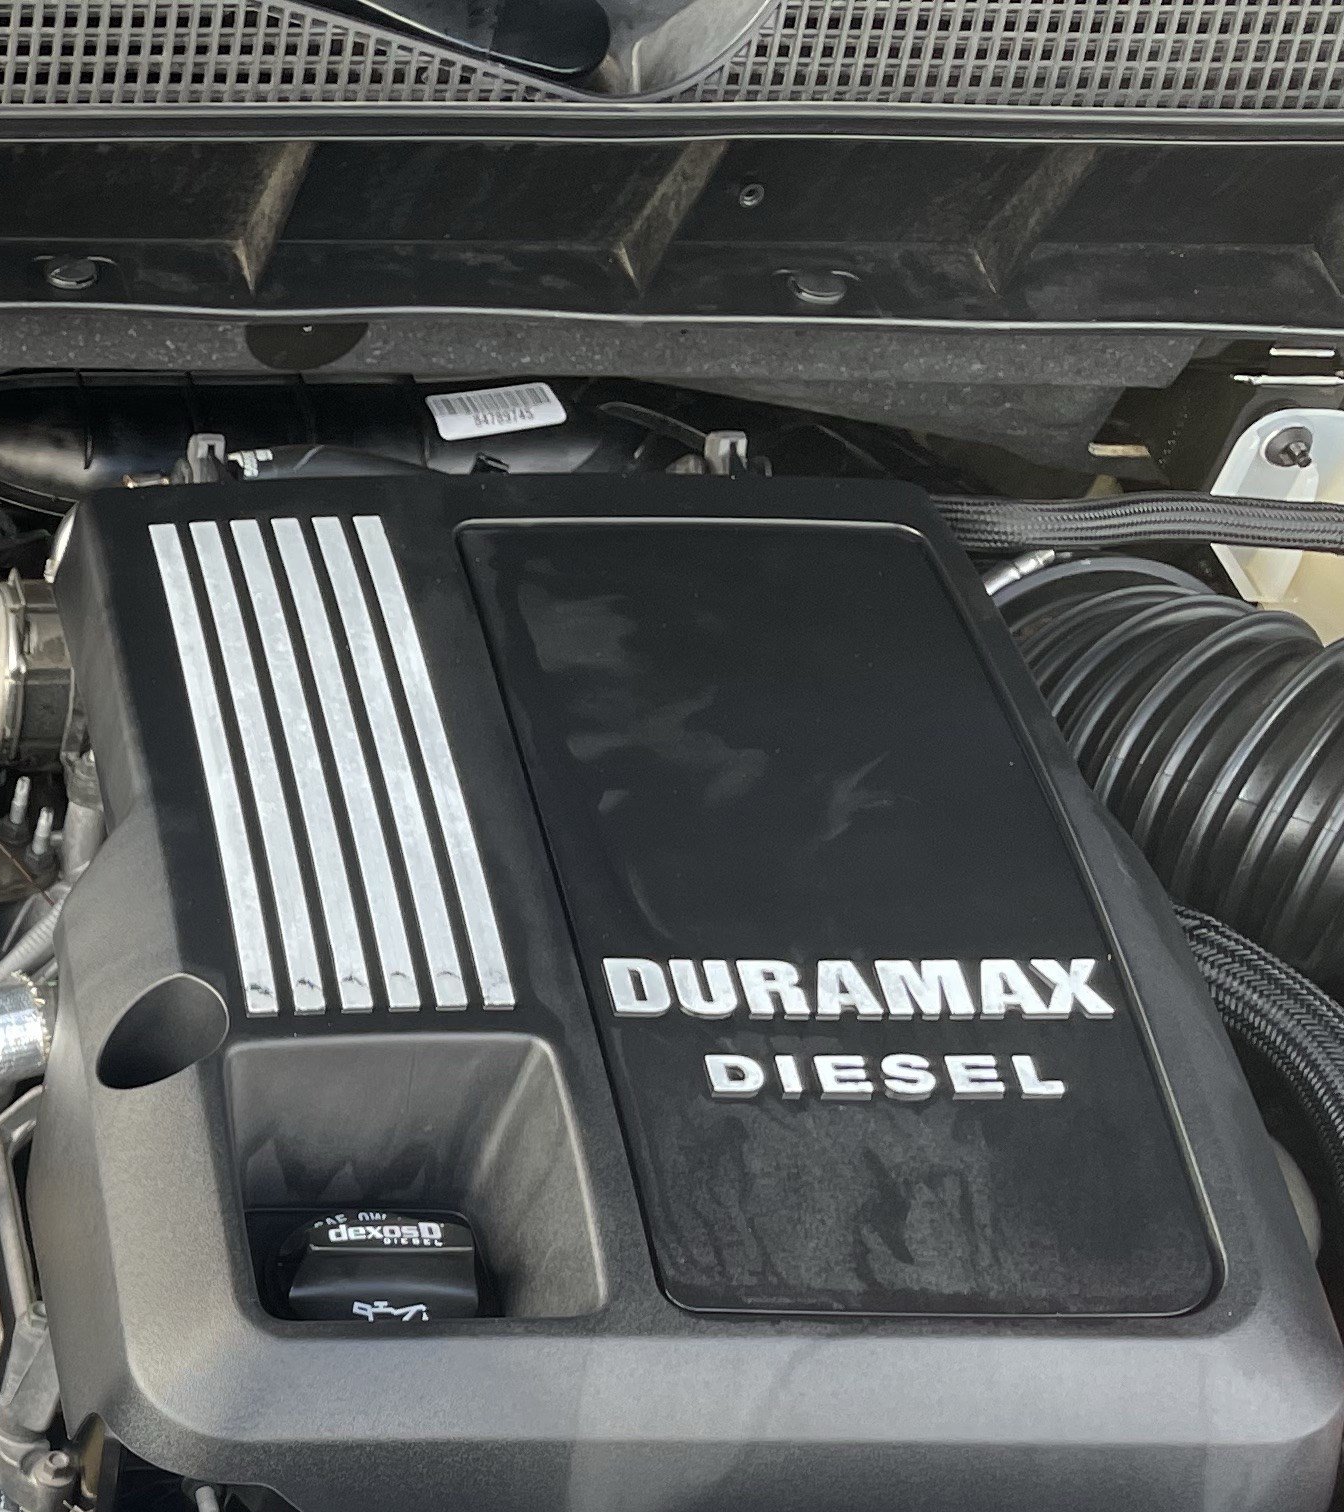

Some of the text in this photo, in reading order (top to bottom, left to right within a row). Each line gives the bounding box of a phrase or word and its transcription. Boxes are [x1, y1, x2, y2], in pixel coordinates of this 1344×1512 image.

[602, 957, 1115, 1019] DURAMAX
[704, 1052, 1066, 1098] DIESEL
[383, 1236, 444, 1247] DIESEL
